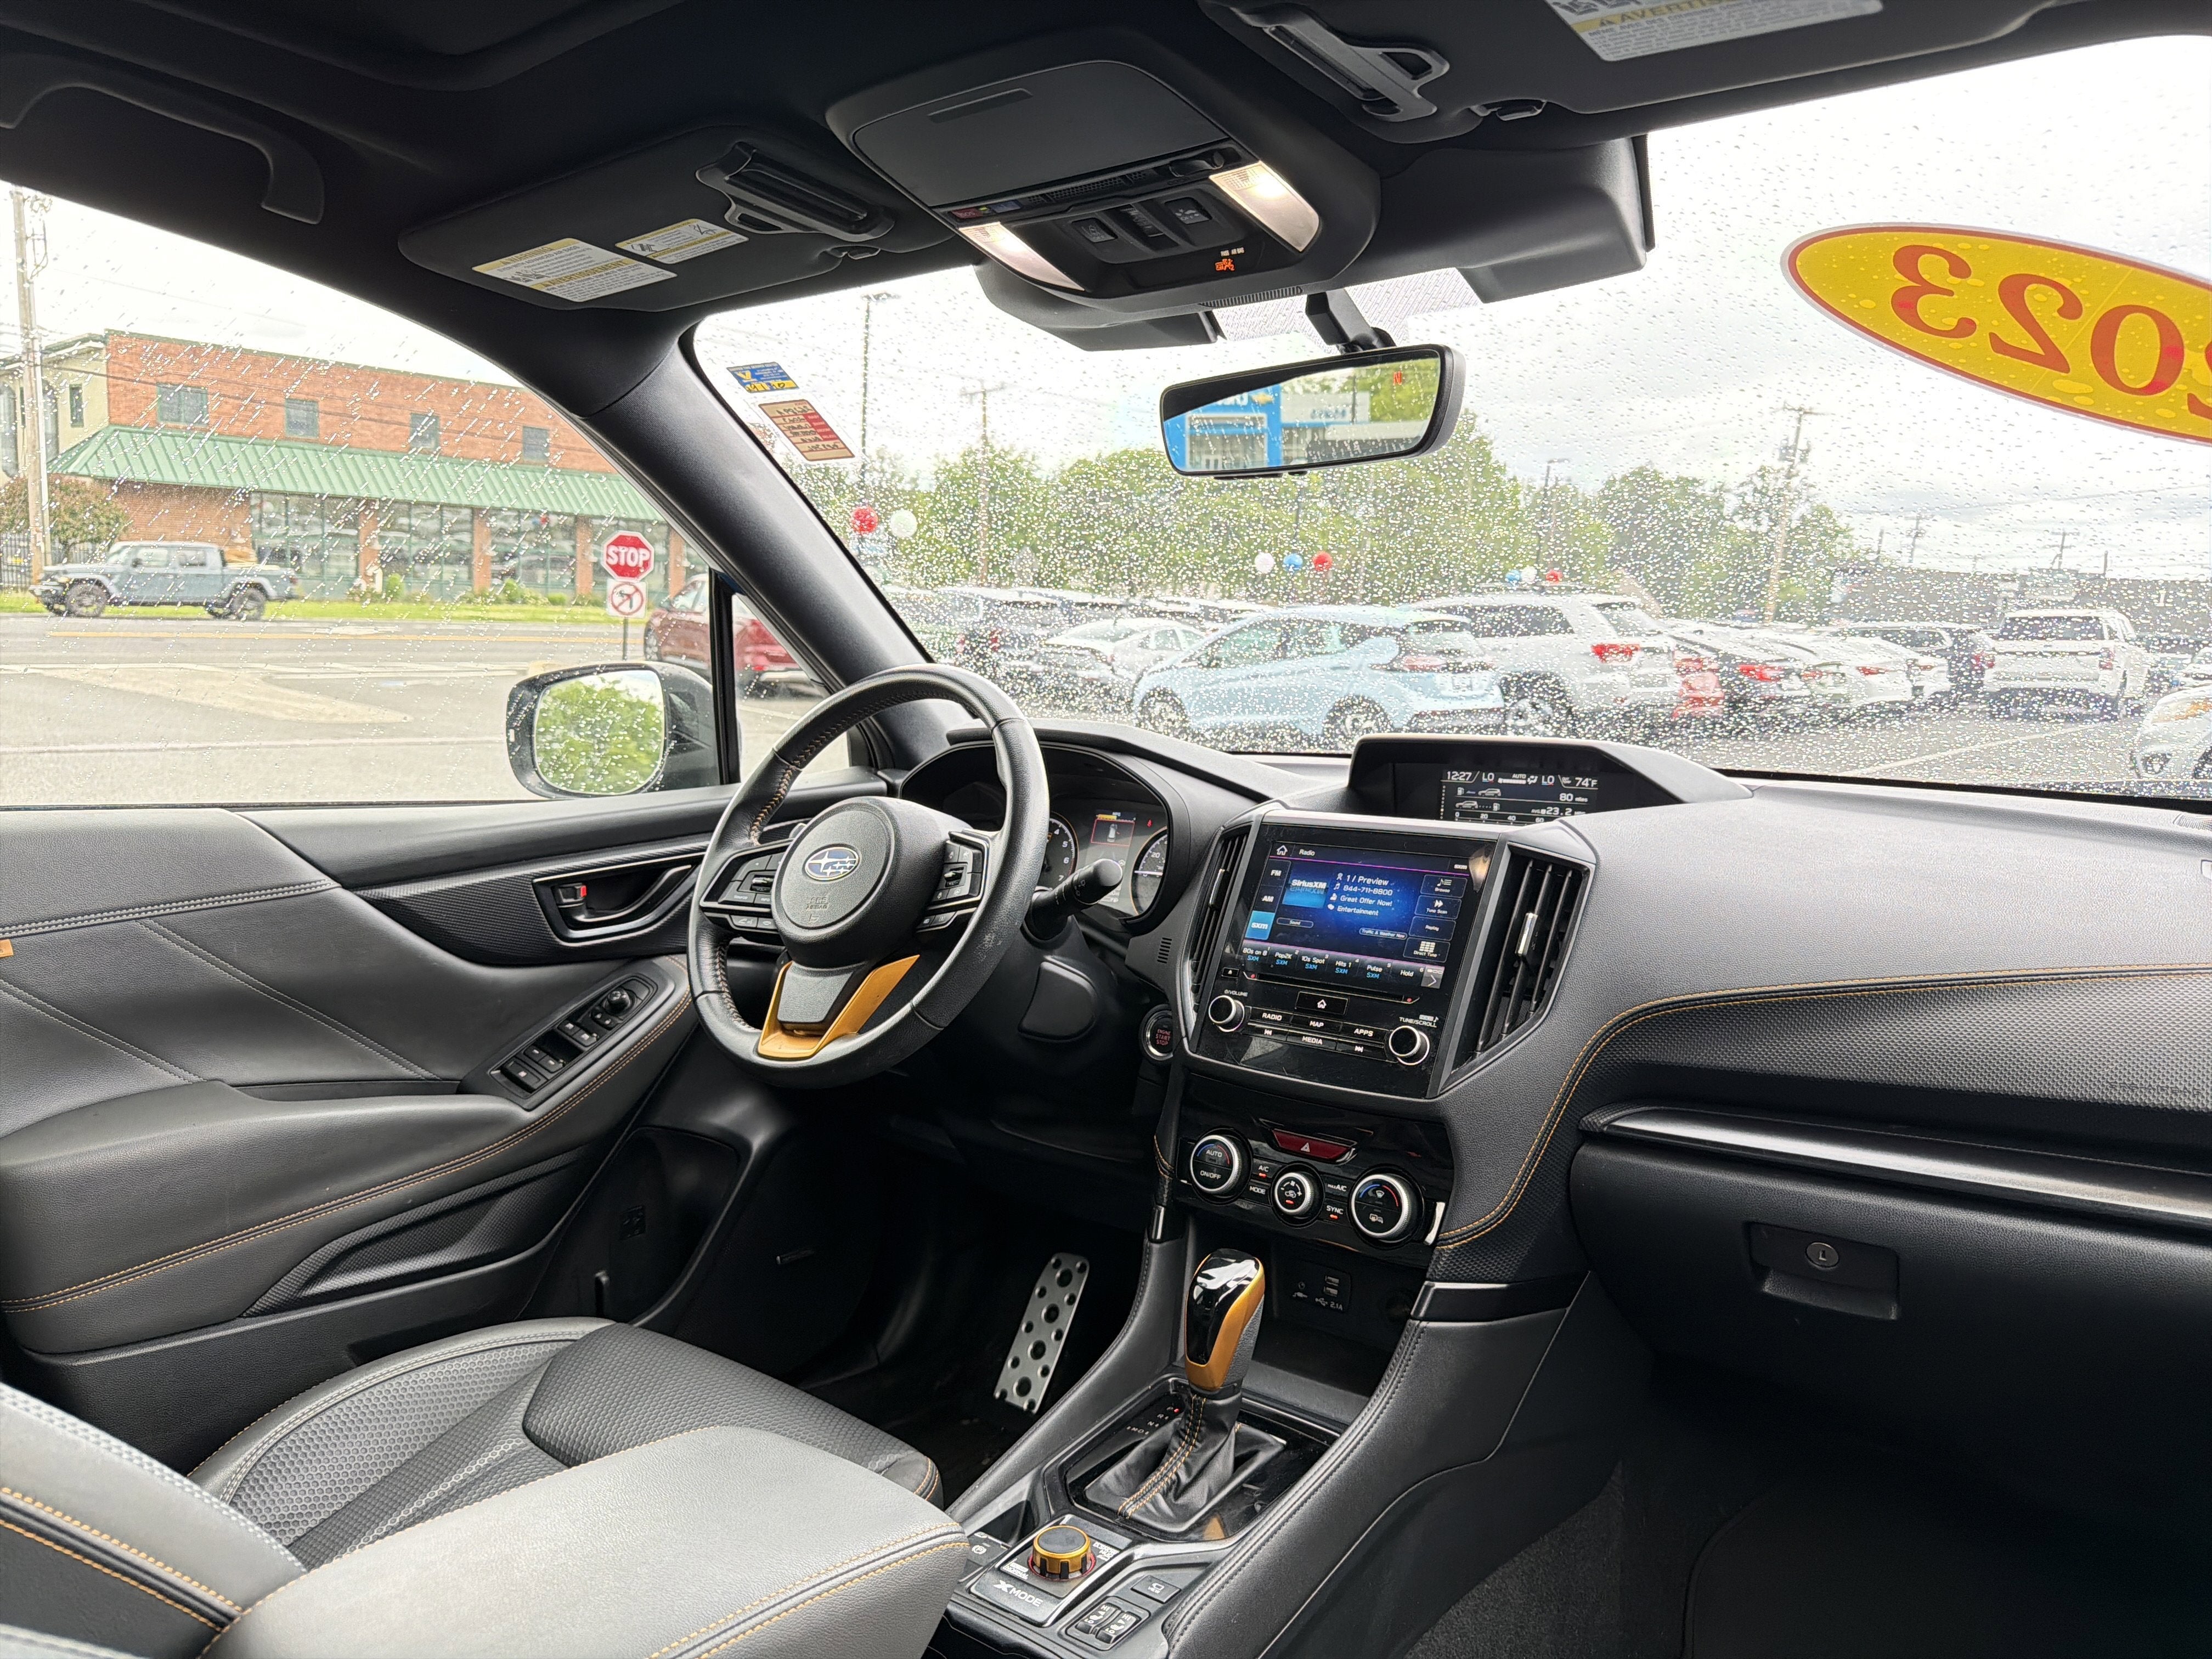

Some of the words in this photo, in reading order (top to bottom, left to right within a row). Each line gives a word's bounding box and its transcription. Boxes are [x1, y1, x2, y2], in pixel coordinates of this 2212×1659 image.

[1392, 371, 1403, 386] N
[607, 546, 650, 567] STOP
[1447, 771, 1472, 781] 12:27
[1482, 772, 1494, 781] LO
[1542, 775, 1555, 784] LO
[1559, 793, 1573, 802] 80
[1546, 806, 1572, 816] 23.2
[1291, 879, 1327, 889] SiriusXM
[1358, 876, 1390, 886] Preview
[1343, 885, 1393, 896] 844-711-8800
[1337, 906, 1379, 916] Entertainment
[1262, 1012, 1283, 1022] RADIO
[1399, 1016, 1437, 1028] TUNE/SCROLL
[1309, 1020, 1324, 1029] MAP
[1354, 1029, 1374, 1037] APPS
[1302, 1036, 1323, 1045] MEDIA
[1206, 1149, 1222, 1158] AUTO
[1200, 1170, 1222, 1180] ON/OFF
[1249, 1187, 1266, 1195] MODE
[1327, 1205, 1344, 1215] SYNC
[1330, 1301, 1343, 1311] 2.1A
[1006, 1566, 1029, 1580] NORMAL
